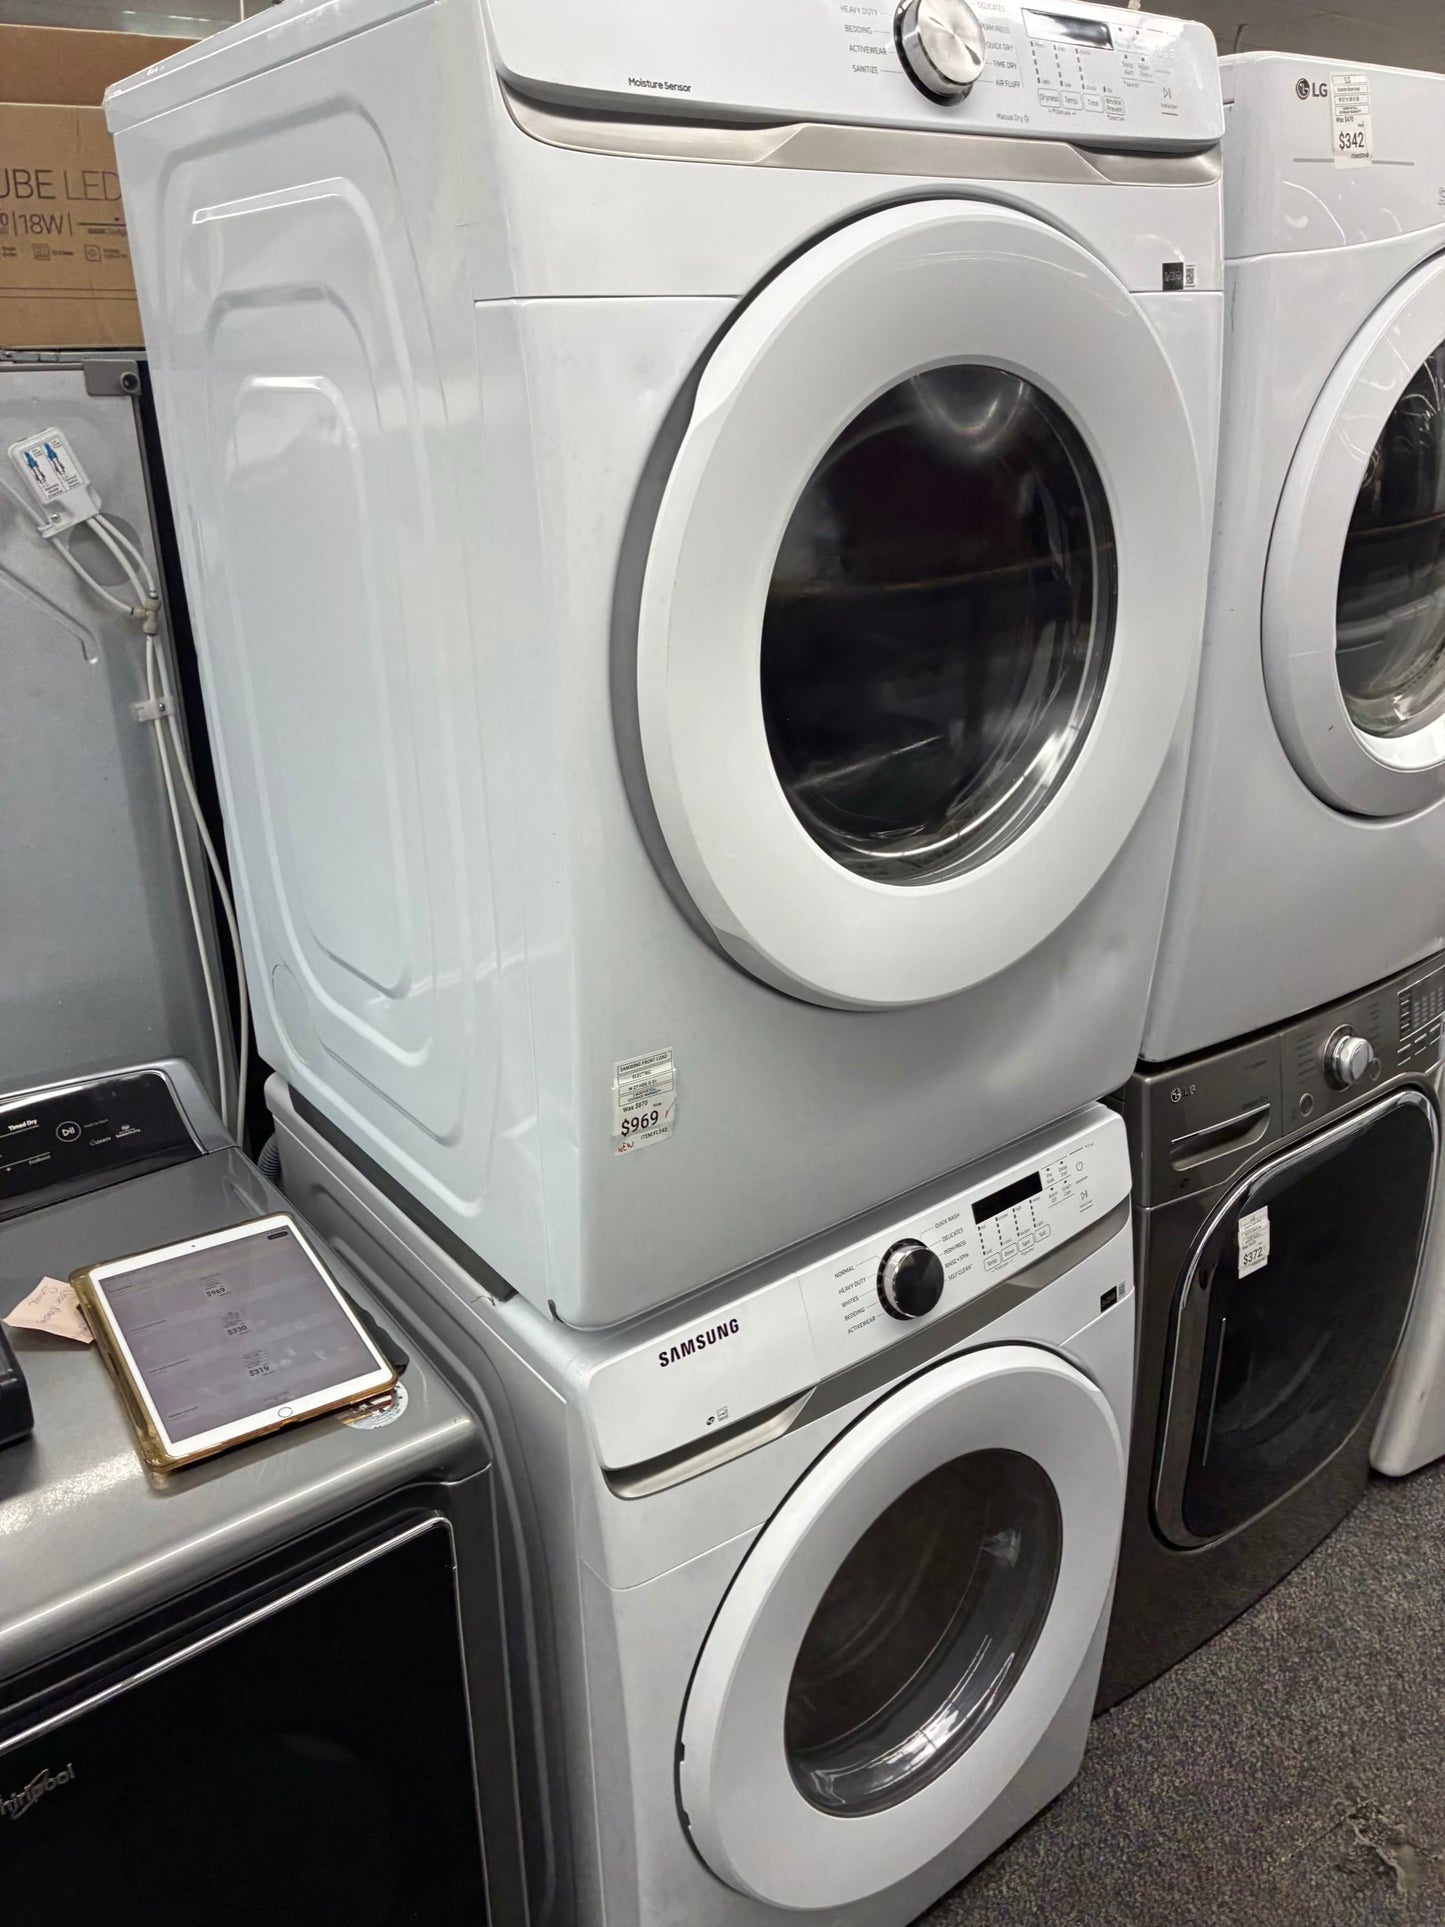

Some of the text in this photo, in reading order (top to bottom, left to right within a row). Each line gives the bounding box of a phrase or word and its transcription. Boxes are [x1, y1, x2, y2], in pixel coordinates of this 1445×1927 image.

[844, 24, 873, 34] BEDDING
[849, 45, 887, 55] ACTIVEWEAR
[852, 64, 879, 74] SANITIZE
[628, 77, 692, 92] Moisture Sensor
[1312, 82, 1328, 97] LG
[1339, 131, 1364, 151] $342
[64, 170, 122, 202] LED
[620, 1053, 667, 1072] SAMSUNG FRONT LOAD
[623, 1105, 634, 1113] Was
[8, 1119, 38, 1131] Timed Dry
[621, 1110, 659, 1137] $969
[942, 1227, 964, 1242] DELICATES
[1243, 1246, 1263, 1266] $372
[834, 1265, 855, 1279] NORMAL
[841, 1295, 859, 1308] WHITES
[844, 1306, 866, 1322] BEDDING
[847, 1315, 876, 1334] ACTIVEWEAR
[658, 1318, 740, 1367] SAMSUNG
[248, 1365, 270, 1377] $319
[0, 1762, 75, 1821] hirlpool
